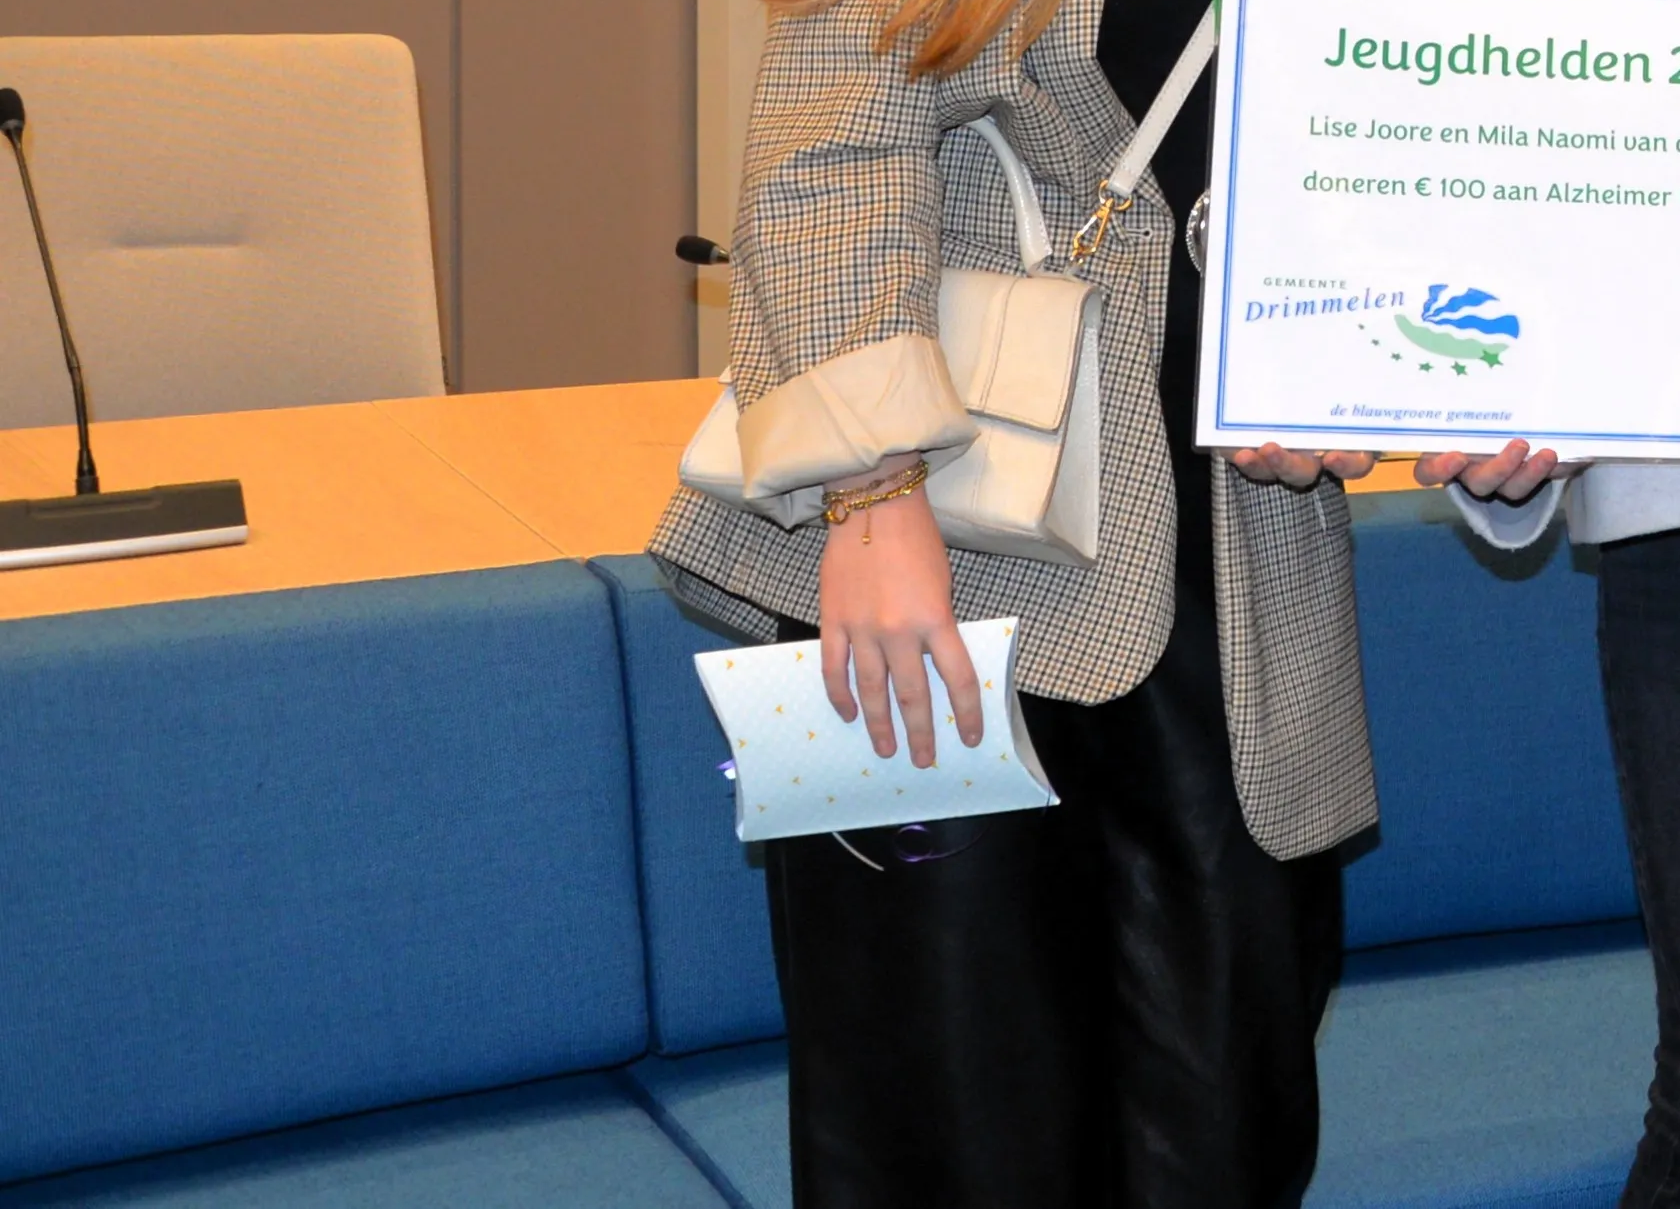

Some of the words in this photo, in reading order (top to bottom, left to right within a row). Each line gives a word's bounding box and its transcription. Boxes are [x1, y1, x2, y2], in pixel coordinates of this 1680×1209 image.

[1323, 27, 1653, 87] Jeugdhelden
[1309, 115, 1358, 139] Lise
[1364, 118, 1433, 142] Joore
[1439, 126, 1469, 144] en
[1478, 124, 1529, 147] Mila
[1537, 127, 1616, 151] Naomi
[1623, 135, 1668, 153] van
[1302, 169, 1407, 196] doneren
[1414, 176, 1432, 197] €
[1440, 177, 1486, 200] 100
[1492, 184, 1538, 202] aan
[1545, 182, 1673, 207] Alzheimer
[1263, 276, 1347, 290] GEMEENTE
[1245, 287, 1406, 323] Drimmelen
[1329, 403, 1348, 417] de
[1351, 403, 1442, 422] blauwgroene
[1445, 409, 1513, 423] gemeente
